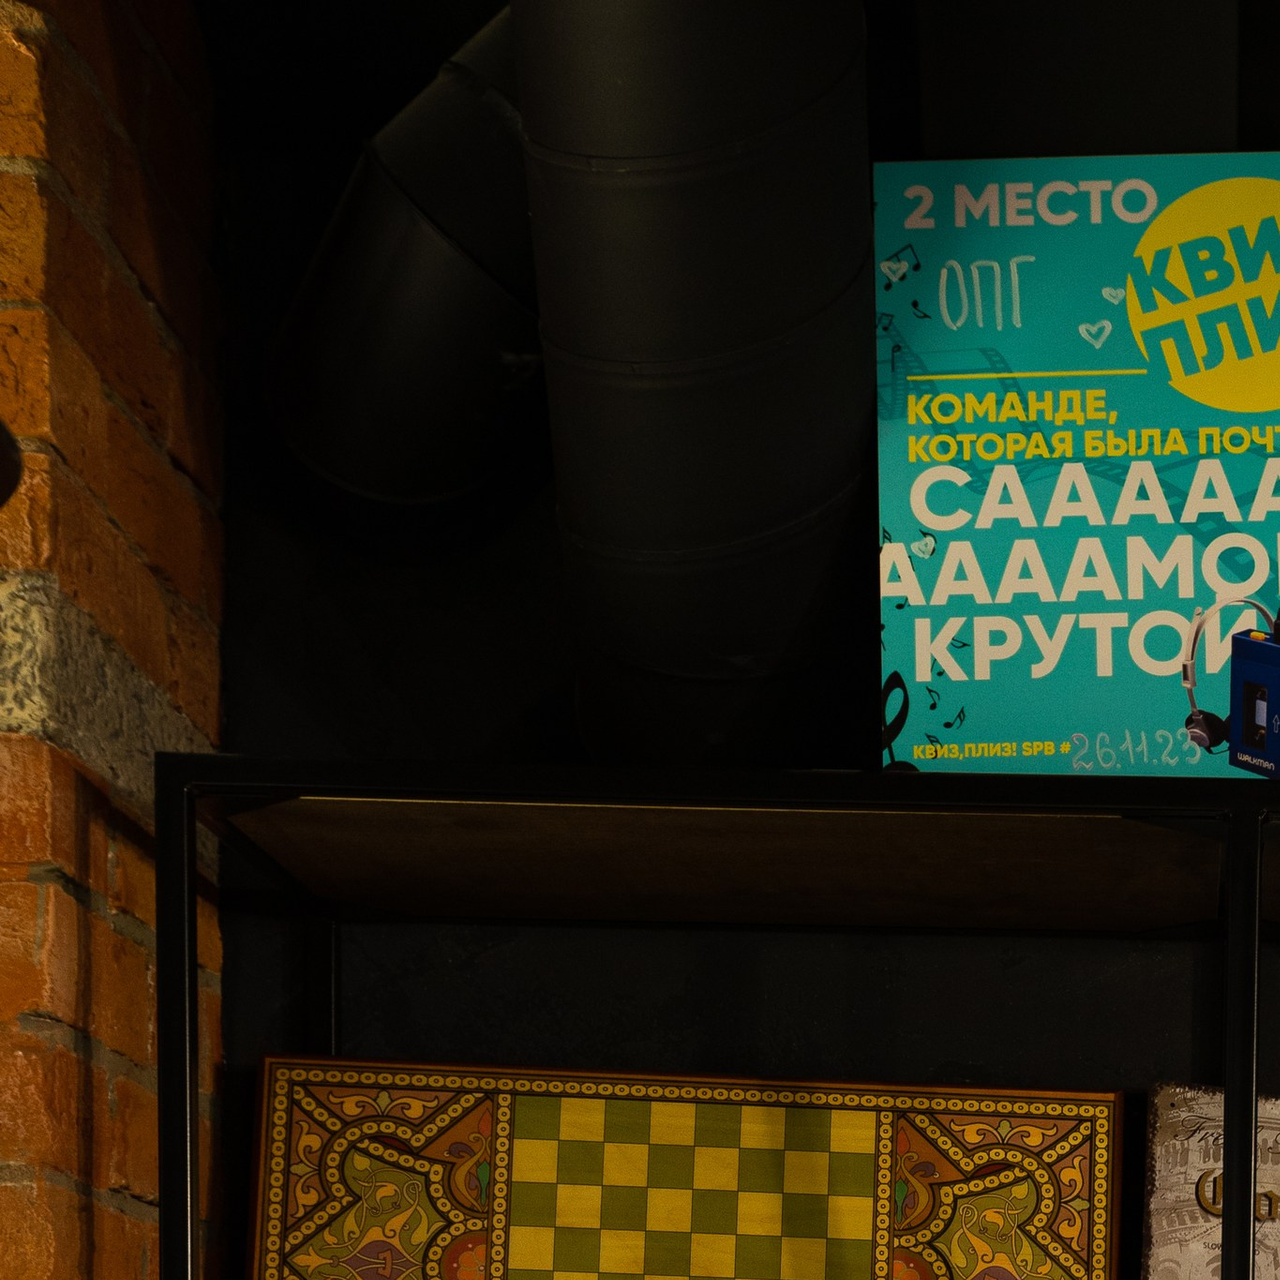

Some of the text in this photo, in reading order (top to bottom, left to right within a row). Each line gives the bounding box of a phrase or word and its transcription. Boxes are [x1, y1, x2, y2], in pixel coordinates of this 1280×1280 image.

[903, 179, 1158, 229] 2 МЕСТО
[939, 255, 1036, 330] ОПГ
[907, 390, 1118, 426] КОМАНДЕ,
[908, 432, 1074, 462] КОТОРАЯ
[1084, 429, 1189, 458] БЫЛА
[914, 598, 1257, 682] КРУТОЙ
[1022, 742, 1056, 756] SPB
[1237, 752, 1275, 770] WALKMAN
[1174, 1115, 1262, 1146] Fre
